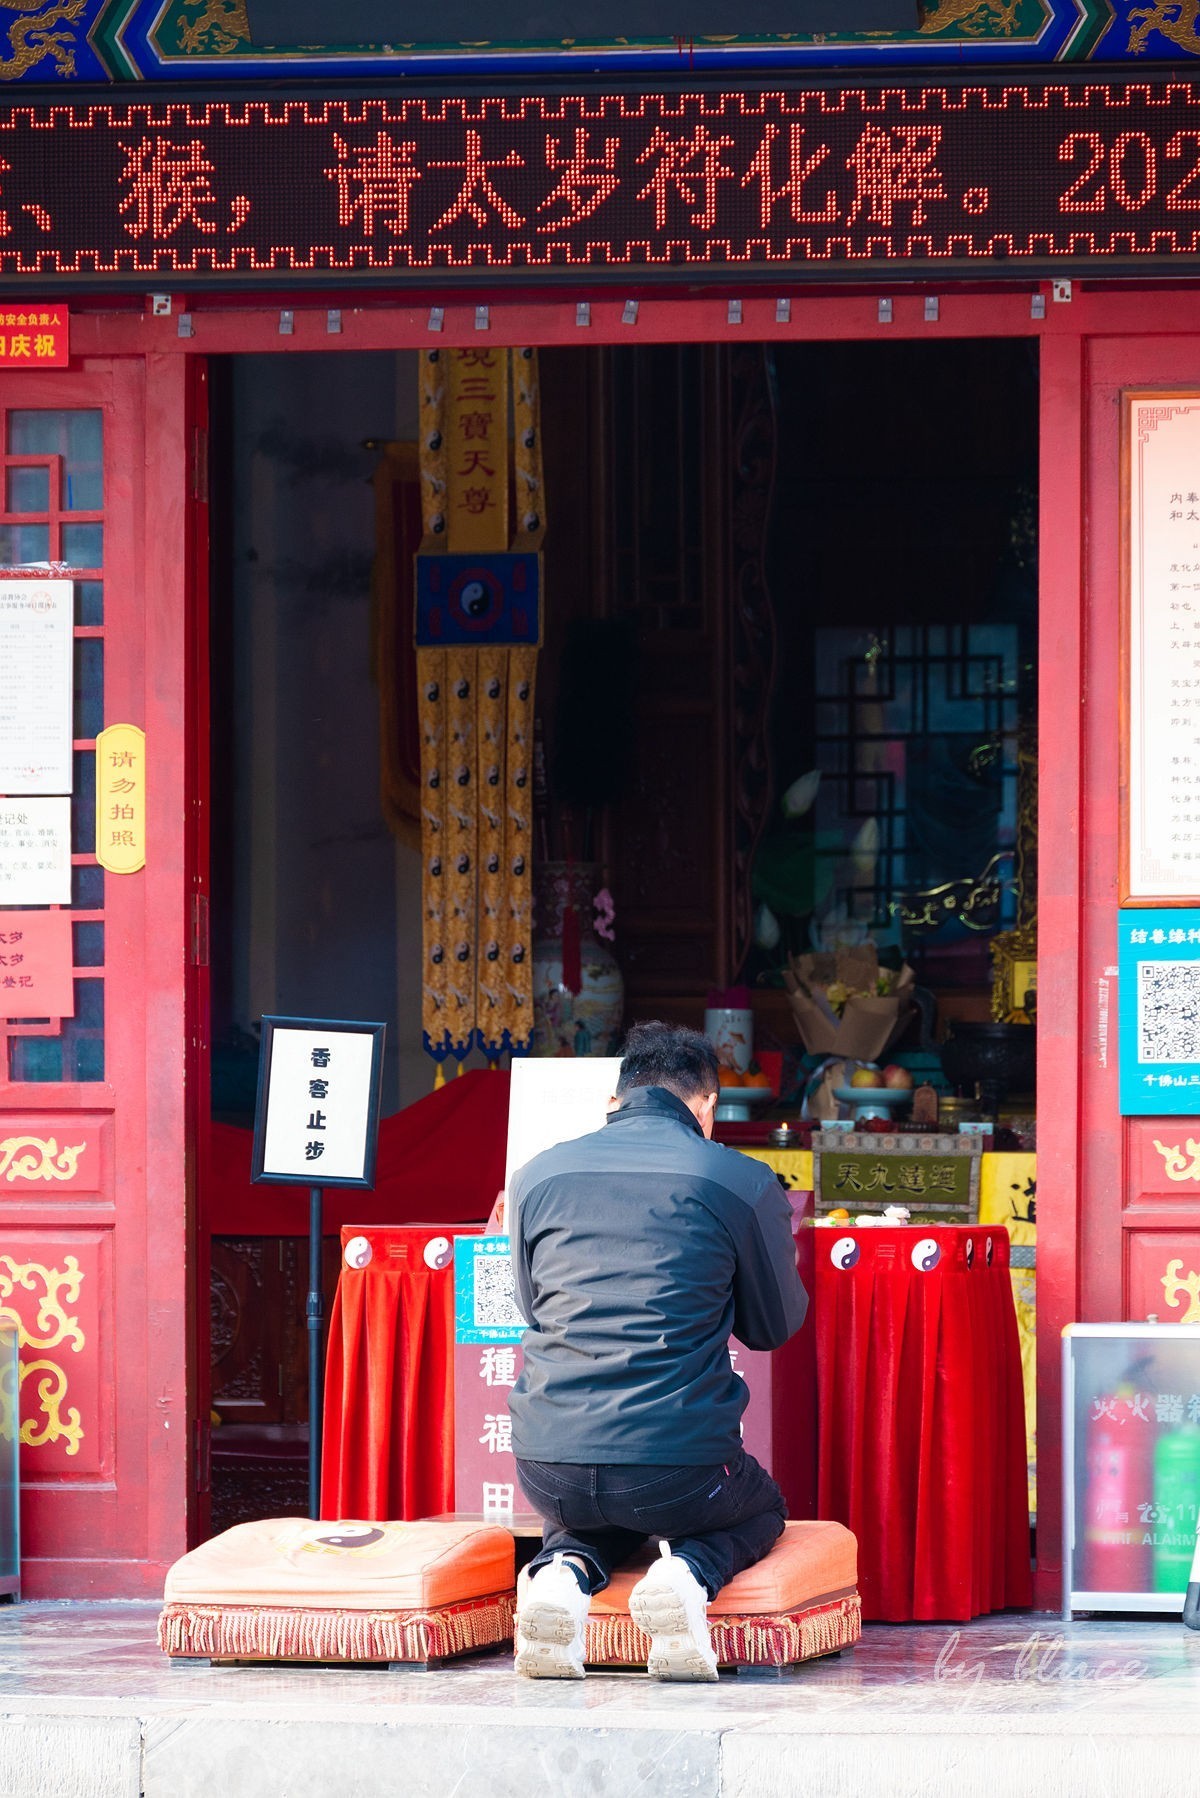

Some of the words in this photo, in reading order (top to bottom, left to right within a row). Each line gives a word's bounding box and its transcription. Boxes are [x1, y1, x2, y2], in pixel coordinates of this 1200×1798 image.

[0, 333, 56, 358] 庆祝
[109, 751, 136, 847] 请勿拍照
[305, 1047, 331, 1161] 香客止步
